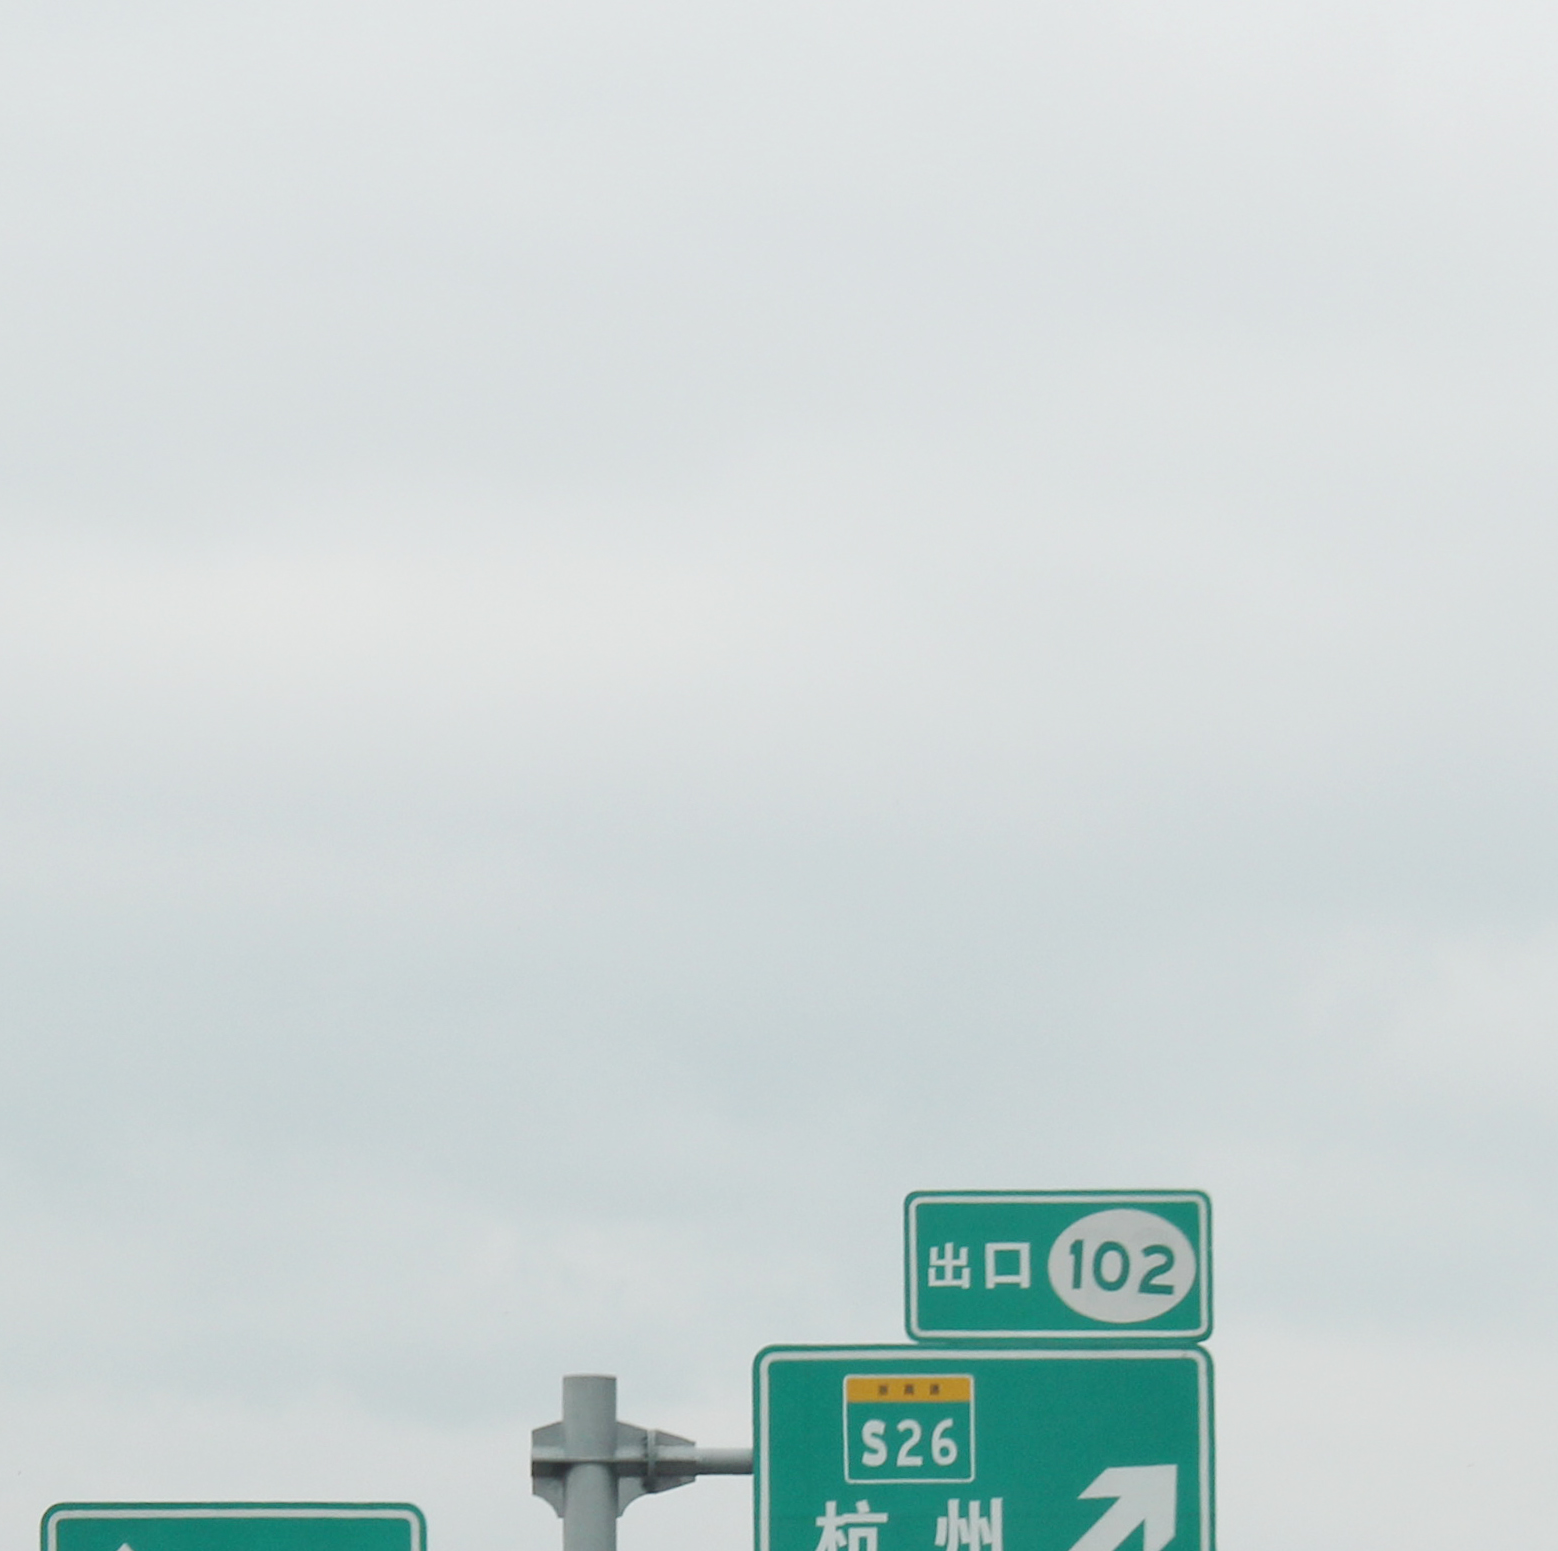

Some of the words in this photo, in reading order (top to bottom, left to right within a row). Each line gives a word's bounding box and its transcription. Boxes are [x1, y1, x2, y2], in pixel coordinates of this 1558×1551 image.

[927, 1242, 1031, 1290] 出口
[1069, 1239, 1175, 1296] 102
[861, 1418, 959, 1467] S26
